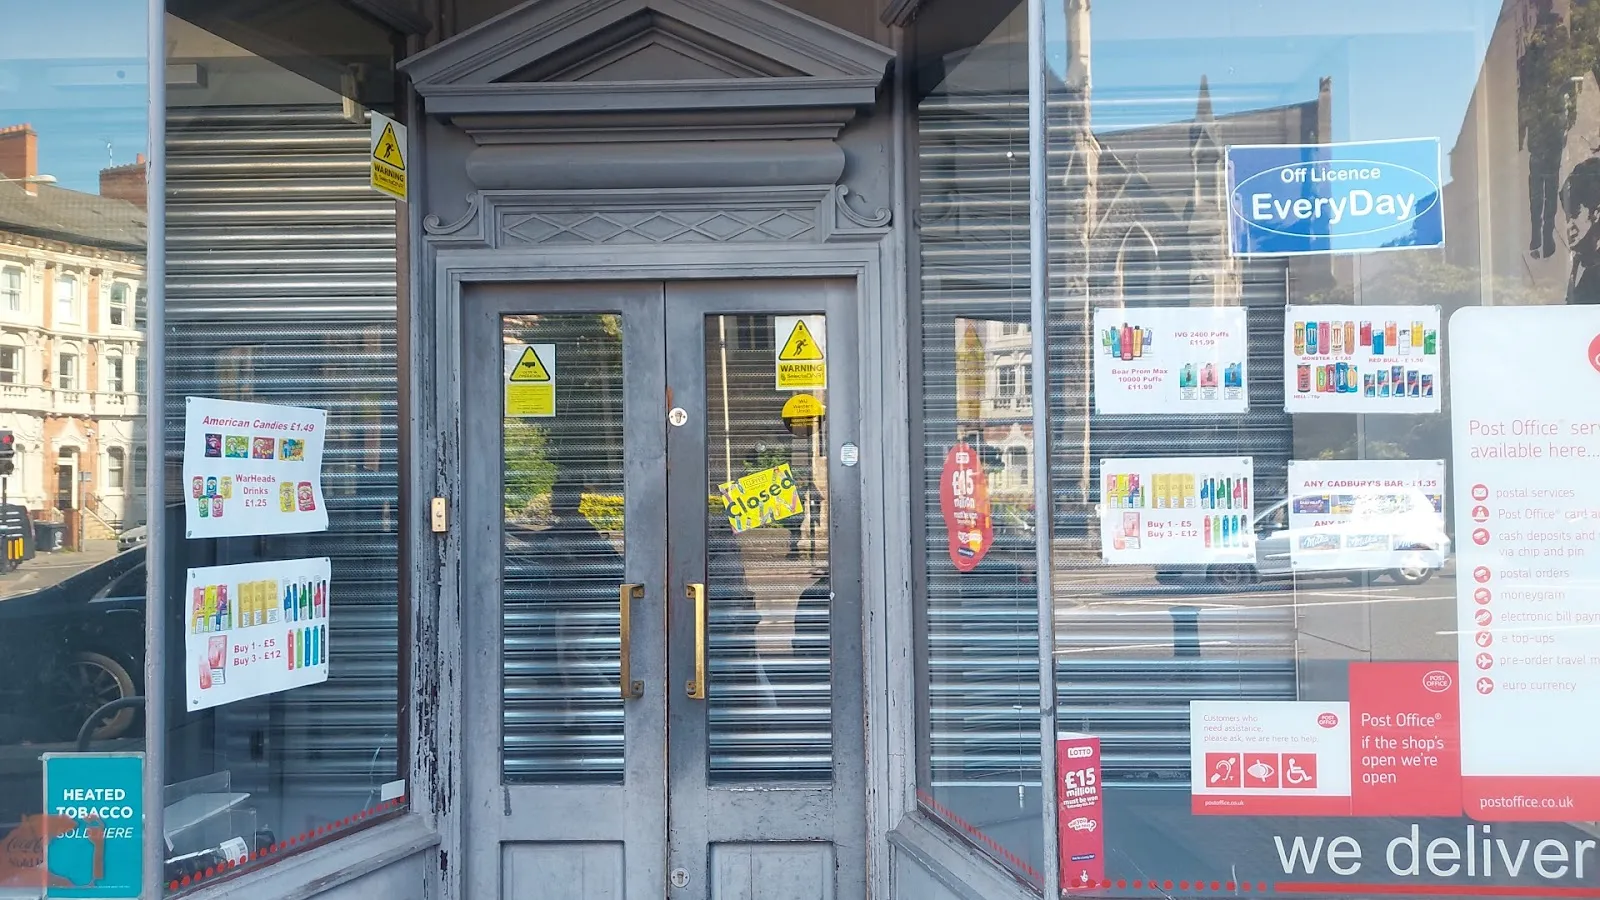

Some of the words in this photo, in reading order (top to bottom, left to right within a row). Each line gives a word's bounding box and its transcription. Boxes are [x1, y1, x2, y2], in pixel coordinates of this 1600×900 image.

[374, 164, 404, 182] WARNING
[1281, 168, 1308, 183] Off
[1311, 166, 1381, 182] Licence
[1252, 189, 1415, 224] EveryDay
[780, 364, 822, 372] WARNING
[202, 416, 250, 428] American
[253, 420, 288, 430] Candies
[290, 423, 314, 433] £1.49
[1469, 420, 1505, 436] Post
[1571, 423, 1600, 435] ser
[1470, 442, 1542, 458] available
[1549, 442, 1600, 458] here...
[236, 474, 276, 483] WarHeads
[243, 487, 269, 495] Drinks
[1496, 488, 1528, 498] postal
[1532, 488, 1575, 498] services
[1498, 509, 1521, 519] Post
[1147, 530, 1164, 538] Buy
[1499, 530, 1522, 540] cash
[1528, 530, 1571, 542] deposits
[1575, 530, 1595, 540] and
[1500, 547, 1514, 556] via
[1518, 546, 1540, 558] chip
[1544, 546, 1564, 556] and
[1568, 547, 1584, 558] pin
[1500, 569, 1532, 579] postal
[1535, 568, 1570, 578] orders
[1501, 591, 1565, 601] moneygram
[1501, 612, 1554, 621] electronic
[1556, 611, 1571, 621] bill
[1512, 634, 1555, 644] top-ups
[234, 645, 248, 655] Buy
[264, 639, 275, 648] £5
[234, 657, 248, 668] Buy
[251, 655, 256, 663] 3
[264, 650, 281, 660] £12
[1500, 656, 1553, 665] pre-order
[1557, 656, 1585, 664] travel
[1530, 682, 1576, 692] currency
[1361, 713, 1392, 727] Post
[1224, 725, 1264, 733] assistance,
[1204, 735, 1227, 744] please
[1361, 736, 1371, 749] if
[1375, 736, 1397, 749] the
[1402, 736, 1444, 751] shop's
[1069, 748, 1091, 757] LOTTO
[1362, 756, 1396, 768] open
[1401, 753, 1438, 766] we're
[1065, 767, 1096, 789] £15
[1362, 773, 1397, 786] open
[63, 788, 126, 801] HEATED
[1066, 785, 1096, 798] million
[1480, 796, 1573, 809] postoffice.co.uk
[56, 806, 133, 819] TOBACCO
[1274, 836, 1362, 875] we
[1386, 824, 1596, 879] deliver
